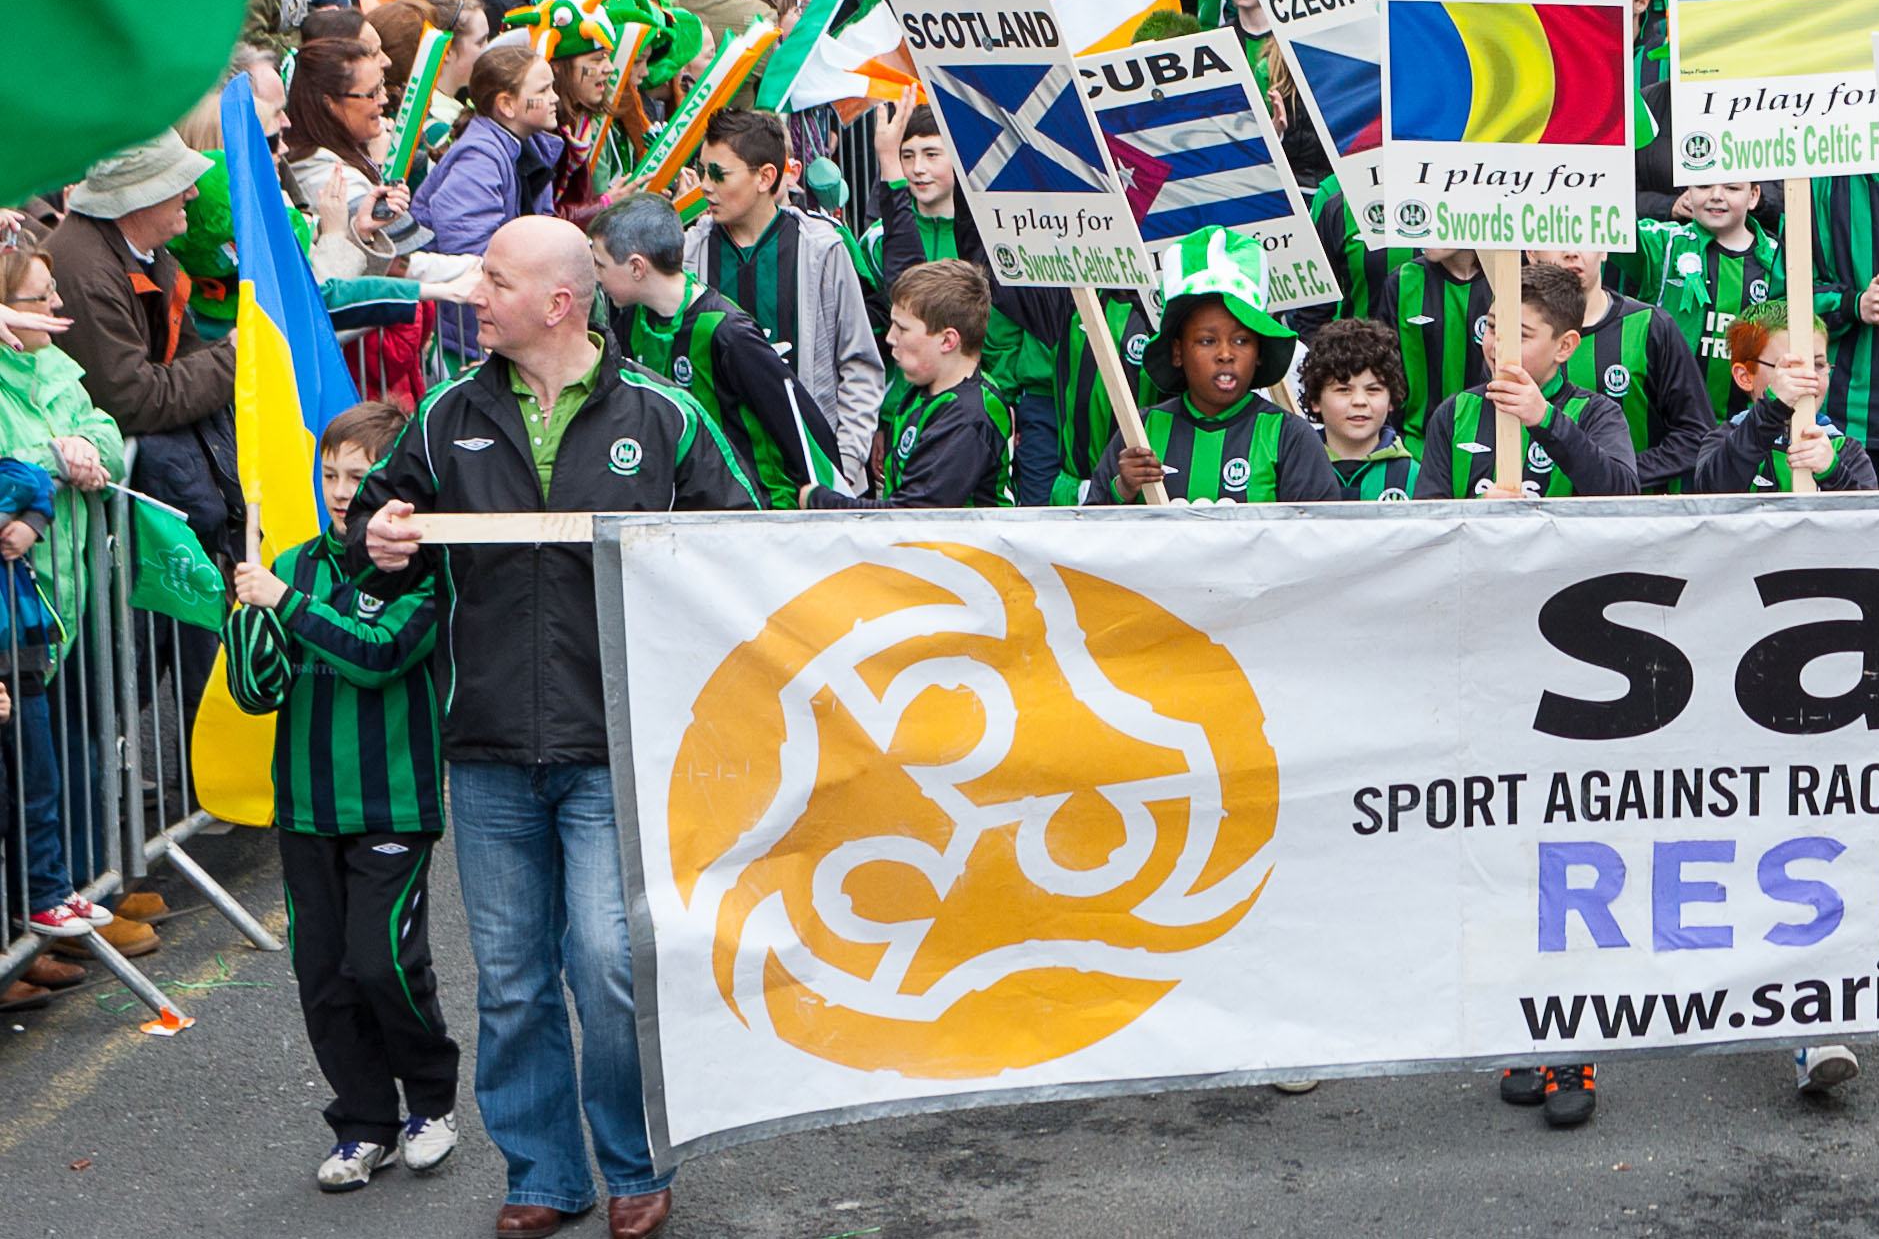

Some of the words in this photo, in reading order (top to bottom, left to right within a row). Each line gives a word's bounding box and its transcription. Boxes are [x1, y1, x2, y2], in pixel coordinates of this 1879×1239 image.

[903, 10, 1060, 51] SCOTLAND
[1079, 44, 1233, 99] CUBA
[1702, 91, 1714, 115] I
[1729, 84, 1815, 120] play
[1721, 129, 1796, 170] Swords
[1803, 123, 1862, 164] Celtic
[1415, 163, 1432, 184] I
[1444, 160, 1534, 193] play
[1535, 162, 1606, 192] for
[1013, 208, 1071, 237] play
[1076, 208, 1114, 237] for
[1436, 203, 1515, 245] Swords
[1520, 205, 1586, 245] Celtic
[1591, 205, 1628, 246] F.C.
[1018, 245, 1075, 282] Swords
[1075, 247, 1116, 282] Celtic
[1118, 249, 1149, 285] F.C.
[1298, 260, 1332, 294] F.C.
[1352, 772, 1528, 837] SPORT
[1543, 765, 1769, 825] AGAINST
